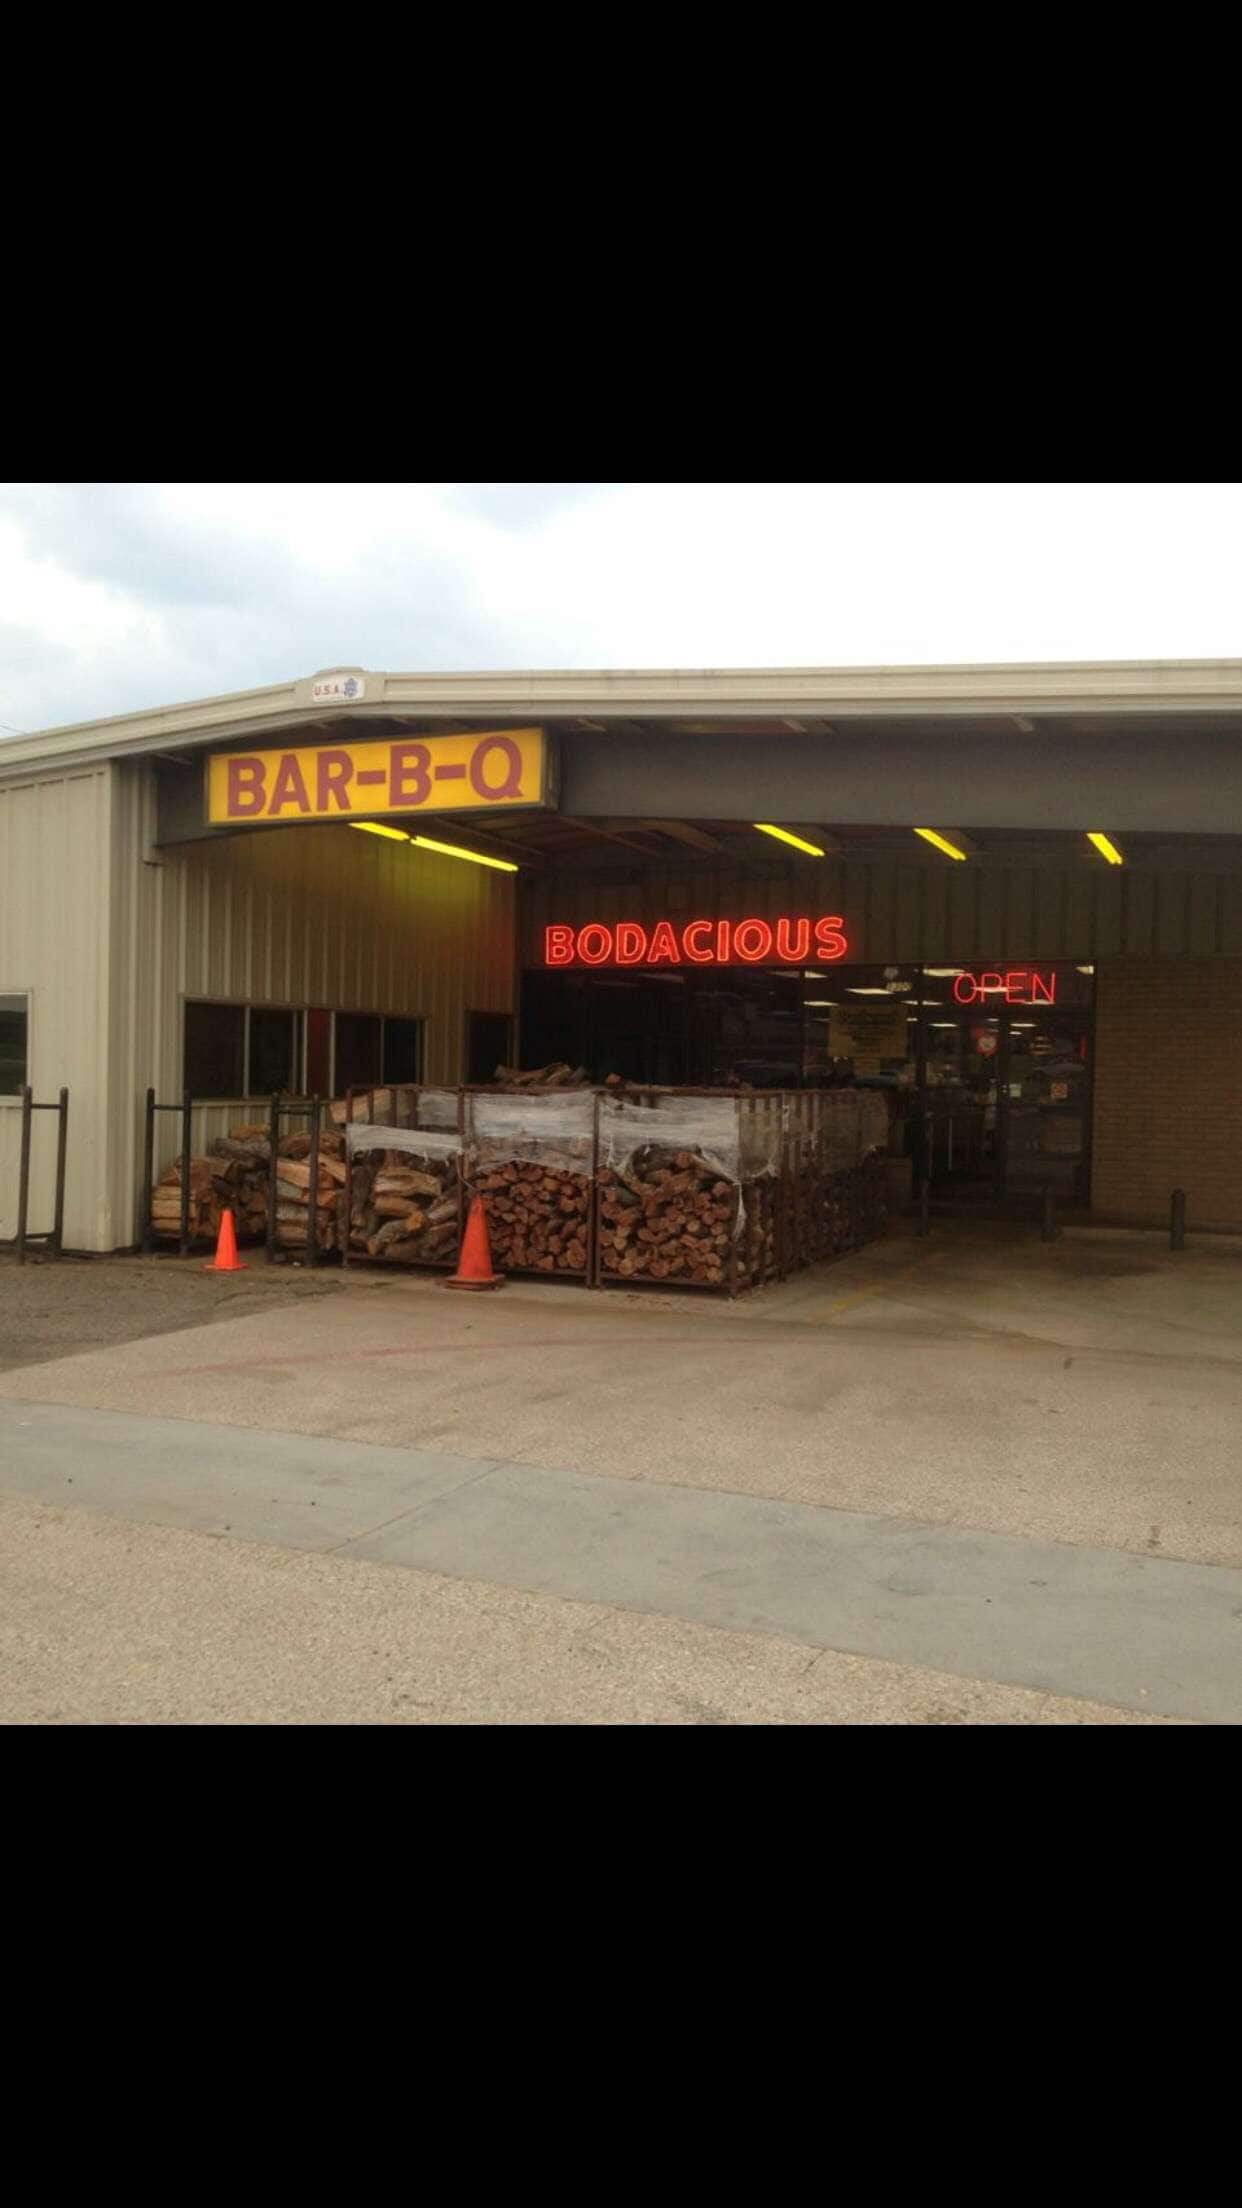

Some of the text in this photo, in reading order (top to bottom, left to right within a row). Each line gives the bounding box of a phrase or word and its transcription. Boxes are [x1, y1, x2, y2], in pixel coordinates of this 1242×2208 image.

[227, 735, 524, 817] BAR-B-Q
[545, 916, 848, 965] BODACIOUS
[953, 971, 1056, 1005] OPEN
